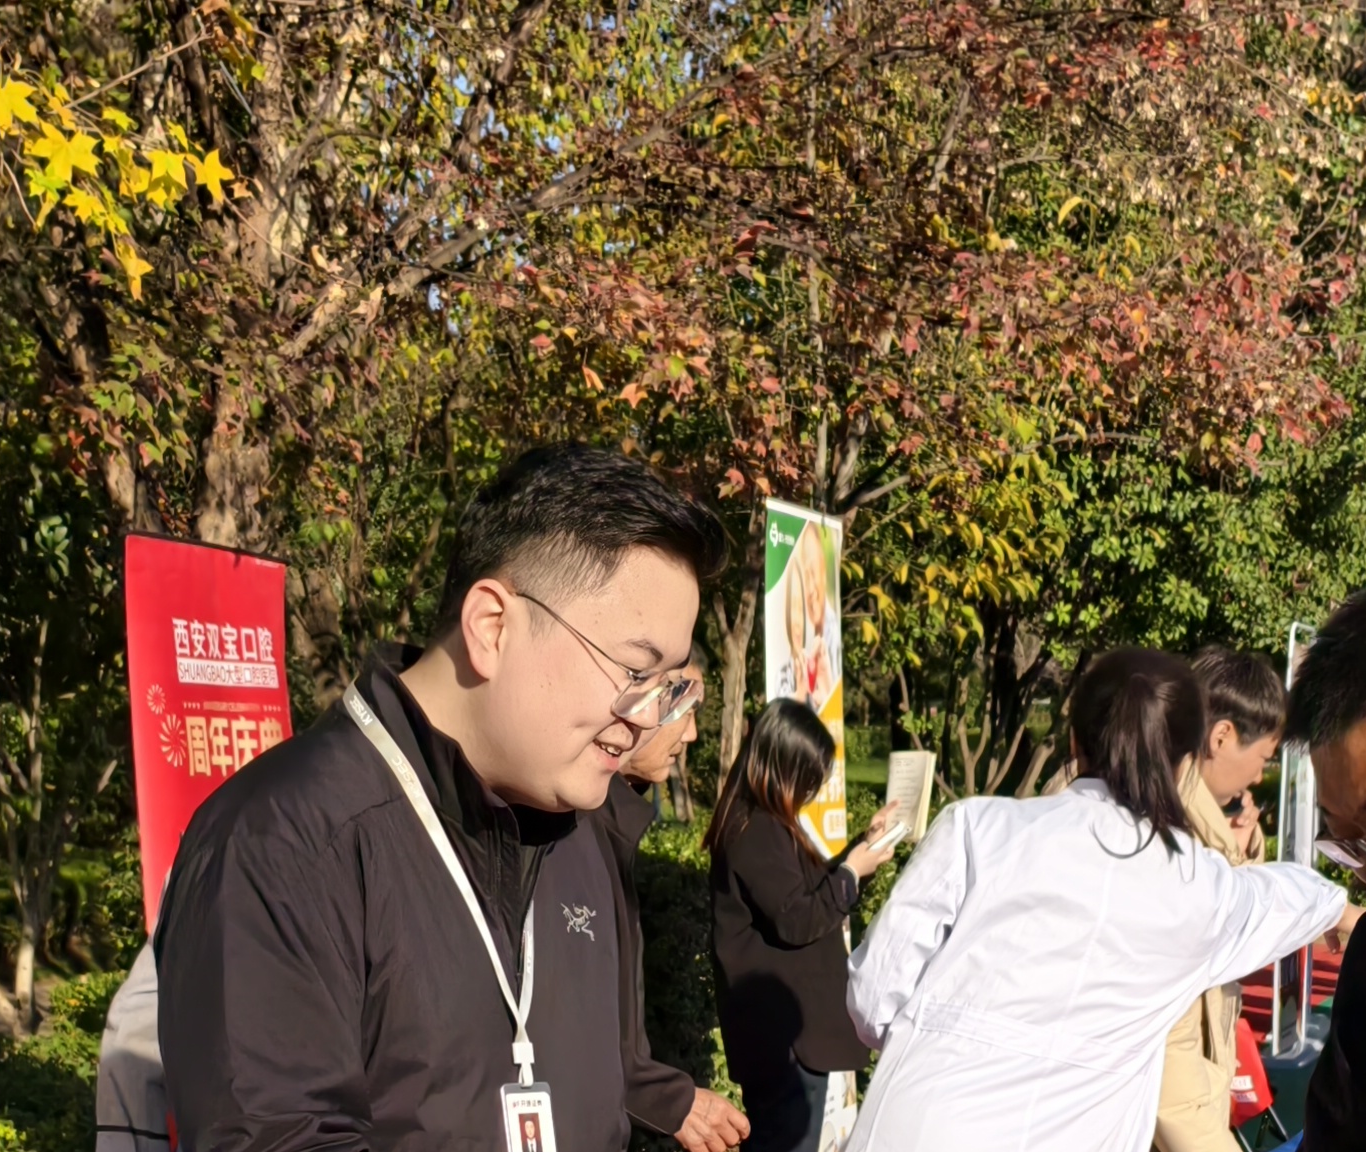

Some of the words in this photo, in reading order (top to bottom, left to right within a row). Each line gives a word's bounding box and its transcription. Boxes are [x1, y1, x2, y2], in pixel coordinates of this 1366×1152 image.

[171, 617, 276, 663] 西安双宝口腔
